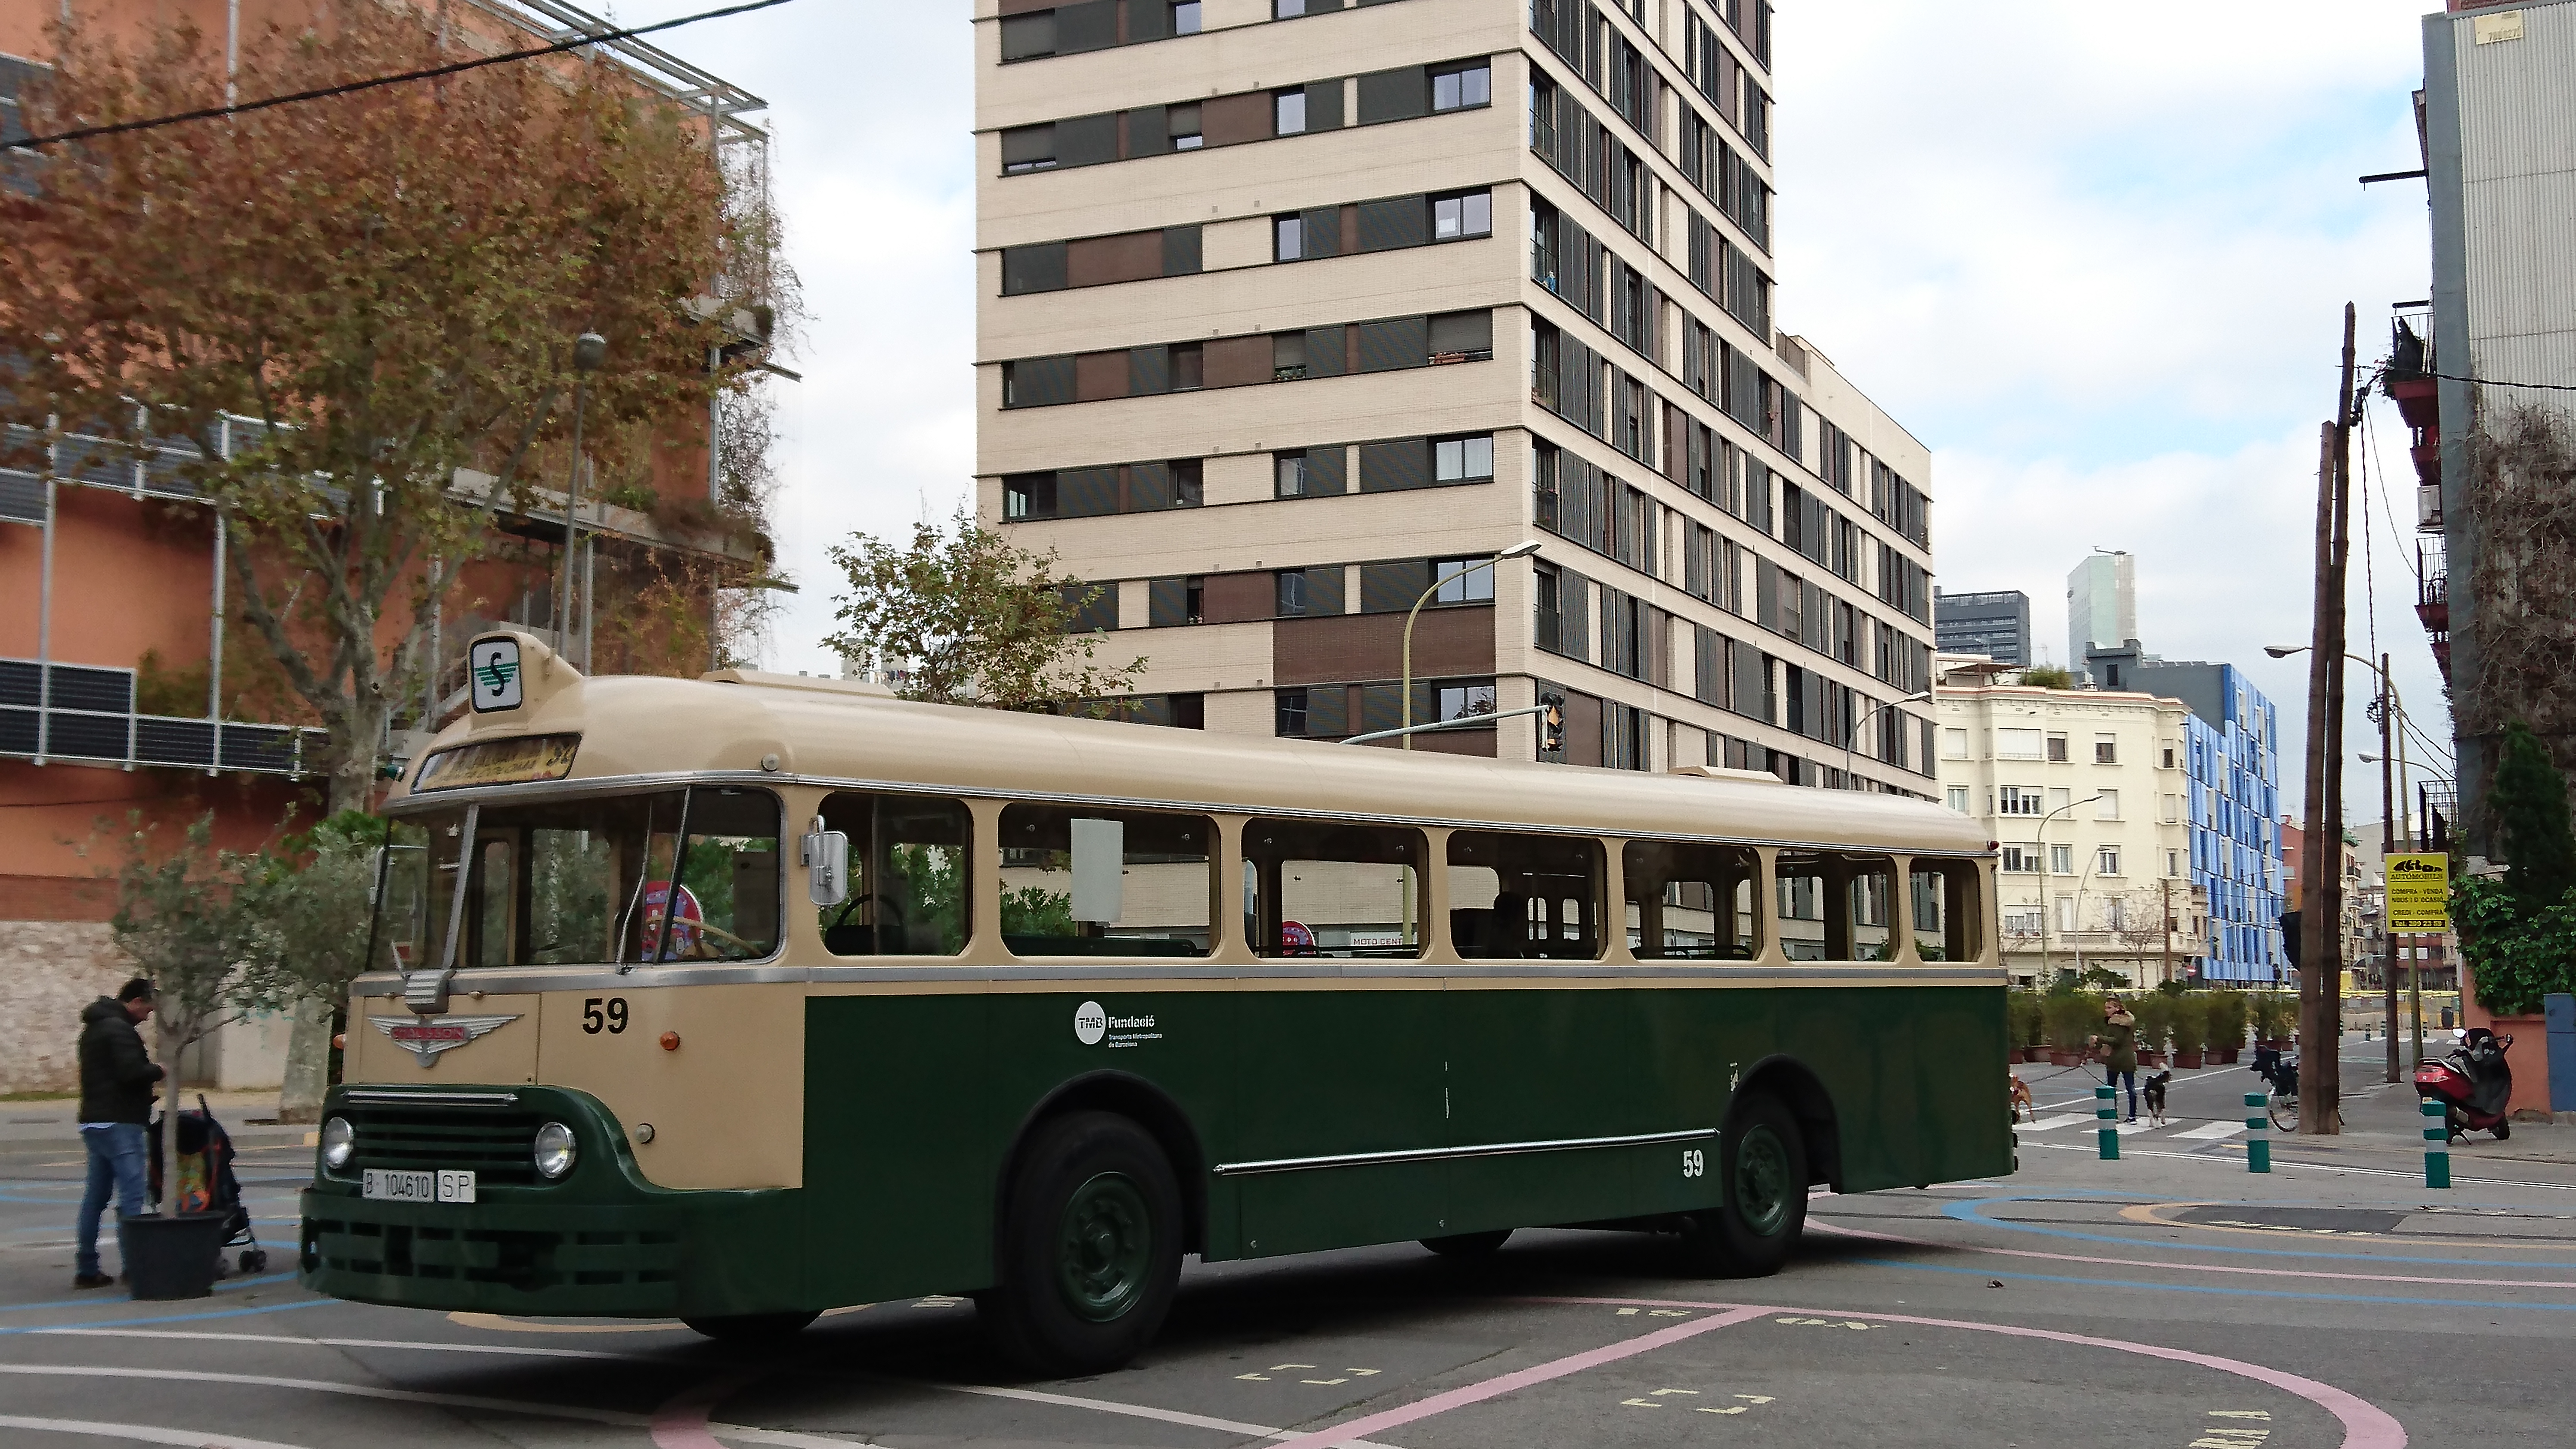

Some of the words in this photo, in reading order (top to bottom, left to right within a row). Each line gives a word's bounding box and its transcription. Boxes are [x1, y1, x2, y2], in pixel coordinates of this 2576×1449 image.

[582, 997, 629, 1034] 59
[1078, 1017, 1103, 1029] TMB
[1108, 1015, 1155, 1028] Fundació
[1683, 1149, 1703, 1177] 59
[385, 1174, 428, 1198] 104610
